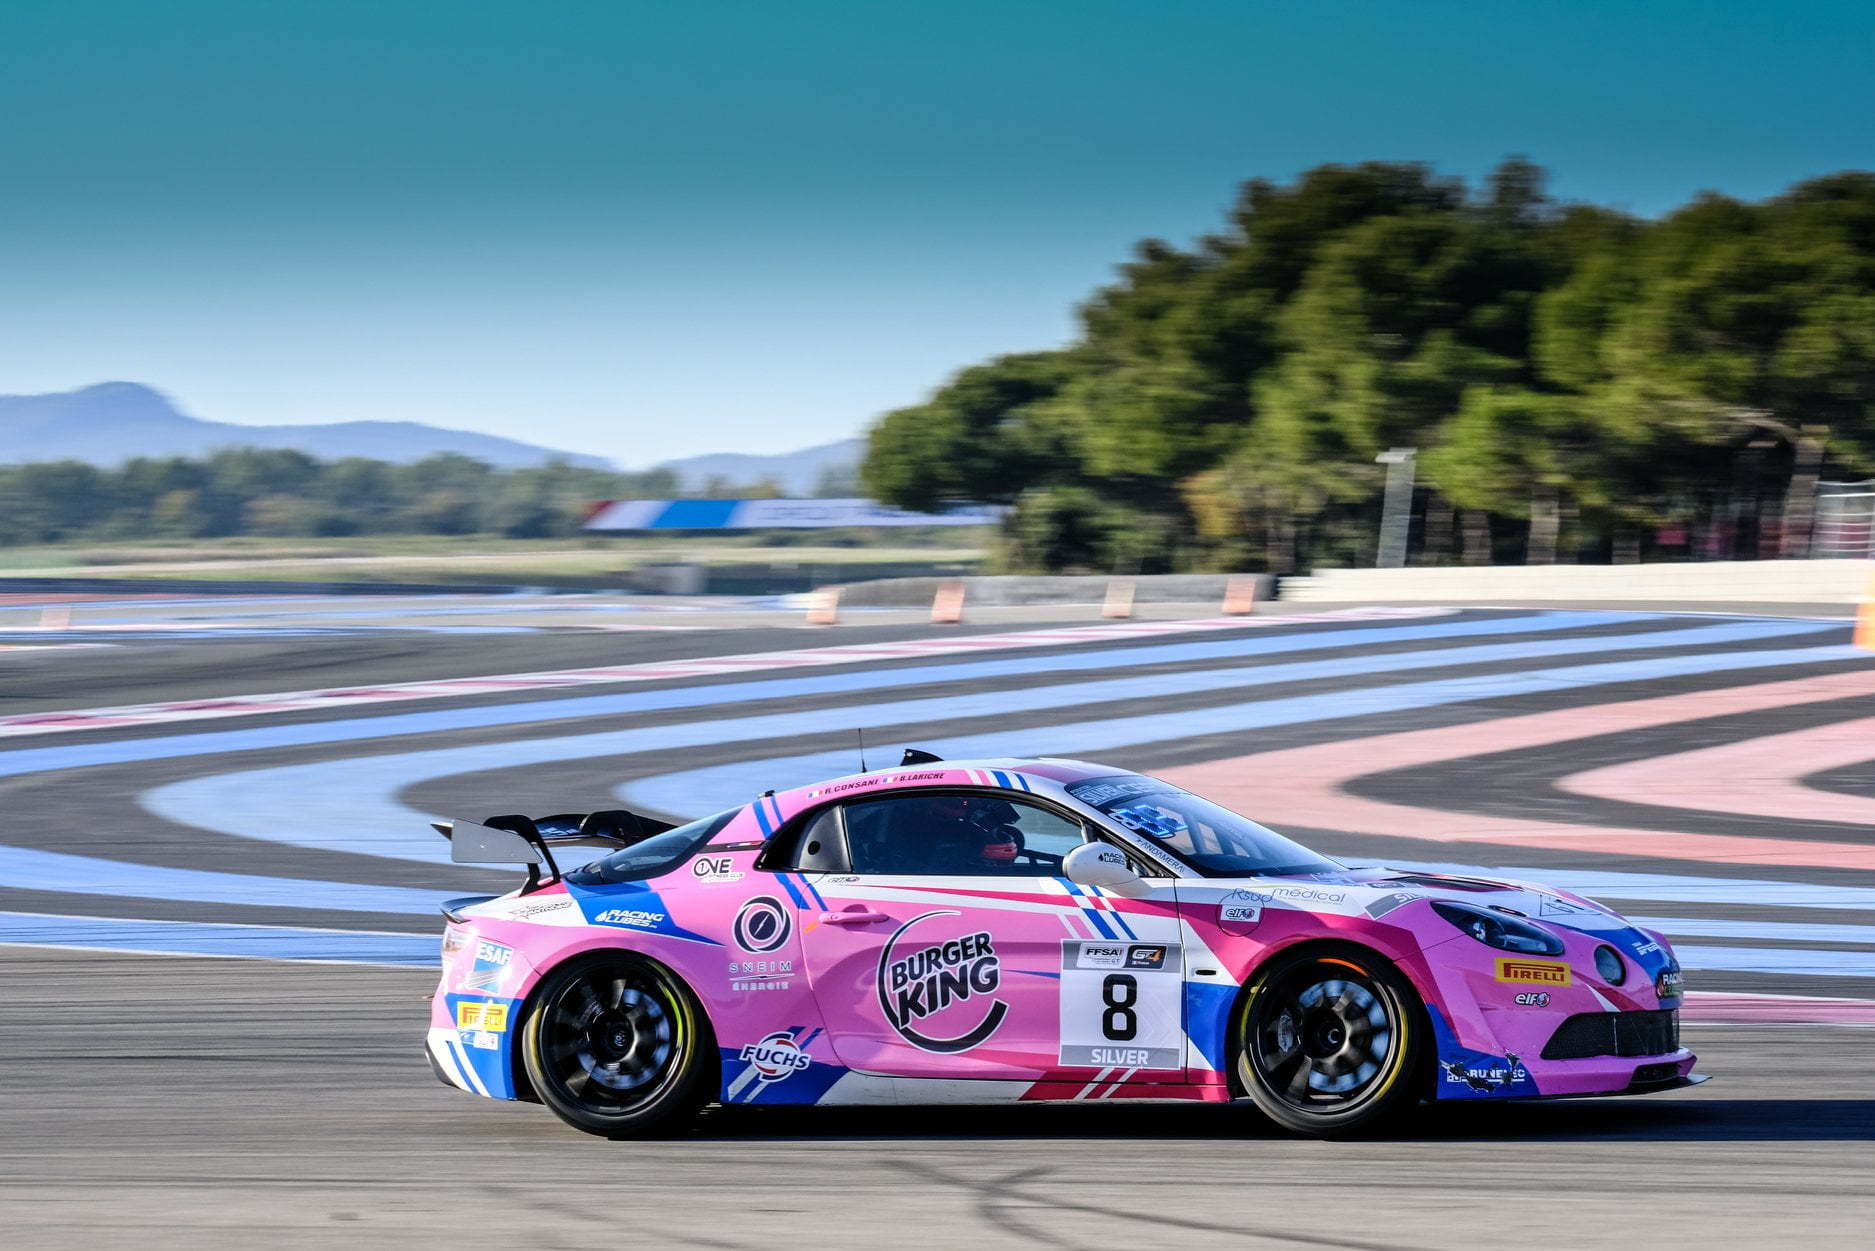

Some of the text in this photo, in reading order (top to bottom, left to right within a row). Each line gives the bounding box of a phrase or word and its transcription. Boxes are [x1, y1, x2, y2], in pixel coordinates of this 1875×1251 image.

[608, 910, 664, 922] RACING
[1086, 948, 1118, 956] FFSA
[730, 961, 792, 973] SNEIM
[892, 932, 993, 992] BURGER
[1503, 962, 1565, 982] PIRELLI
[898, 956, 998, 1028] KING
[1515, 994, 1538, 1004] elf
[1102, 973, 1138, 1042] 8
[742, 1046, 809, 1069] FUCHS
[1091, 1048, 1149, 1065] SILVER
